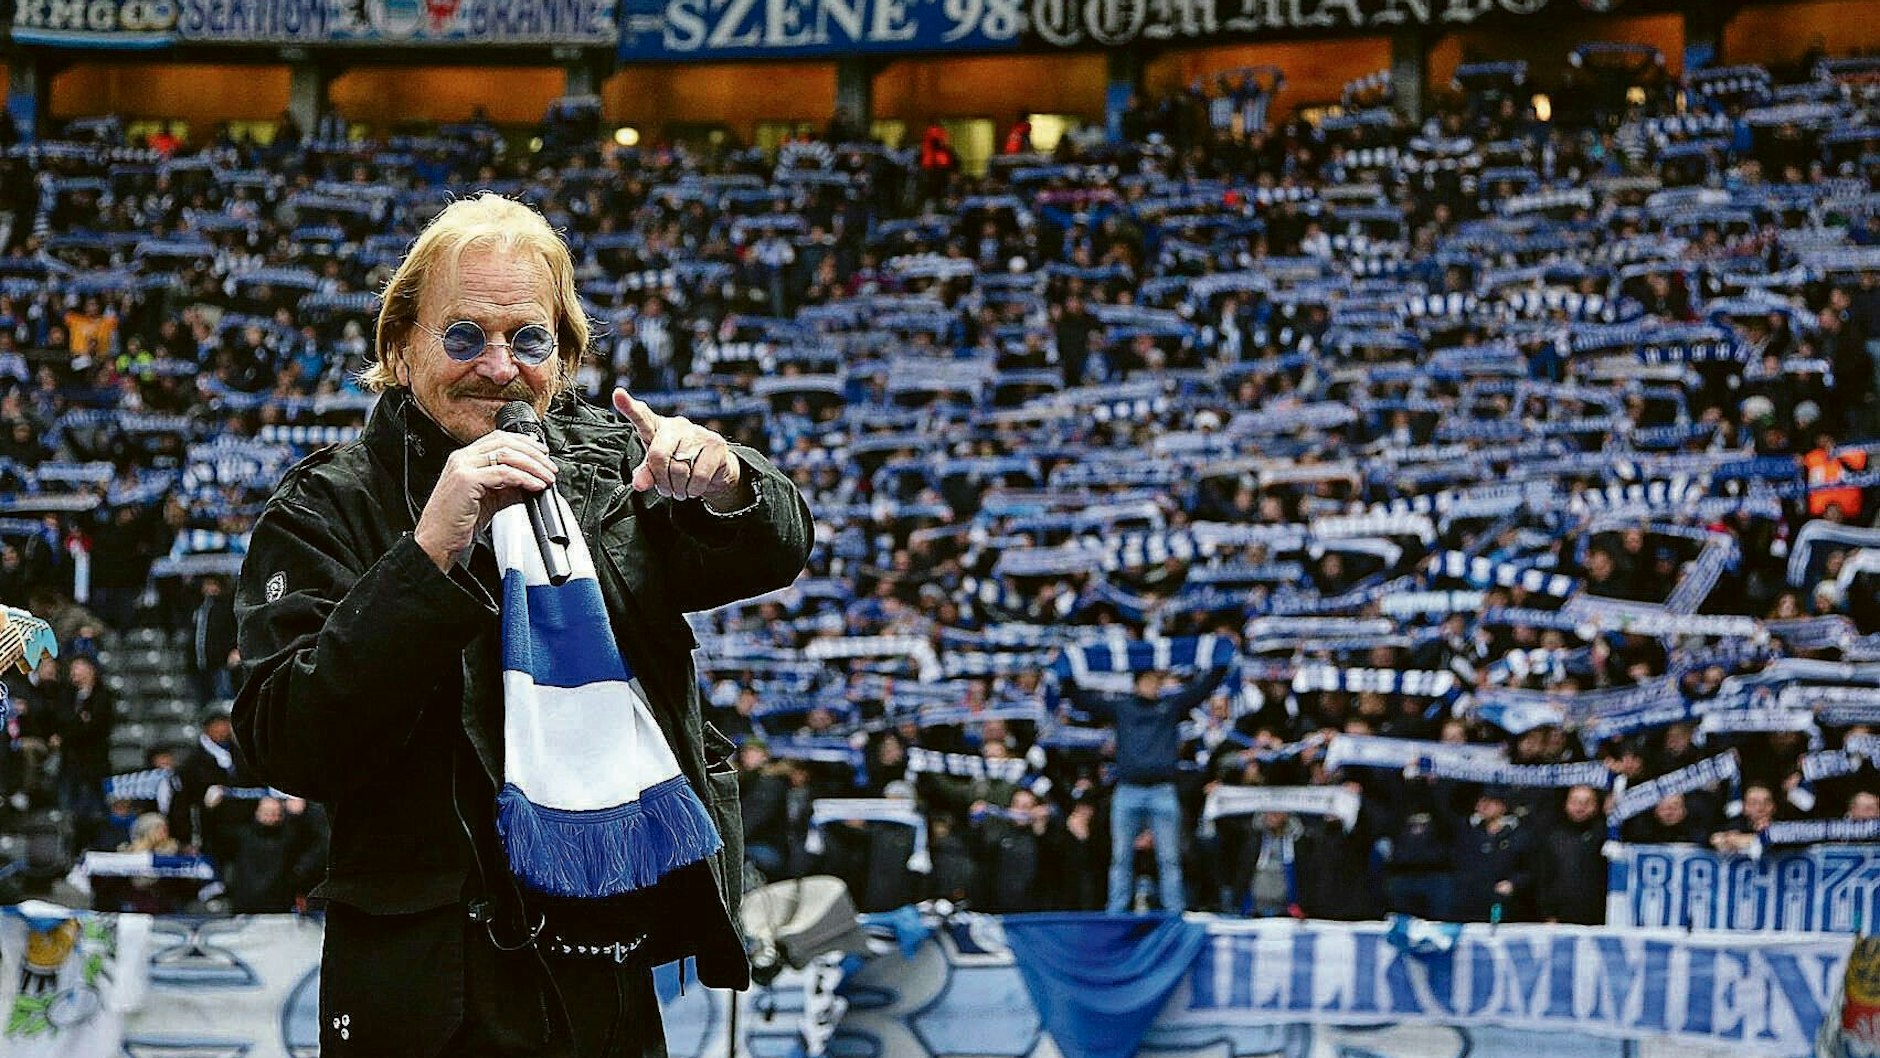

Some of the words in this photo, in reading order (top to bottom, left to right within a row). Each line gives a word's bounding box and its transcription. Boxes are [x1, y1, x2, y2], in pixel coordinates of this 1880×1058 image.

[663, 0, 919, 51] SZENE
[1634, 853, 1880, 932] RAGAZ
[1186, 930, 1838, 1054] ILLKOMMEN
